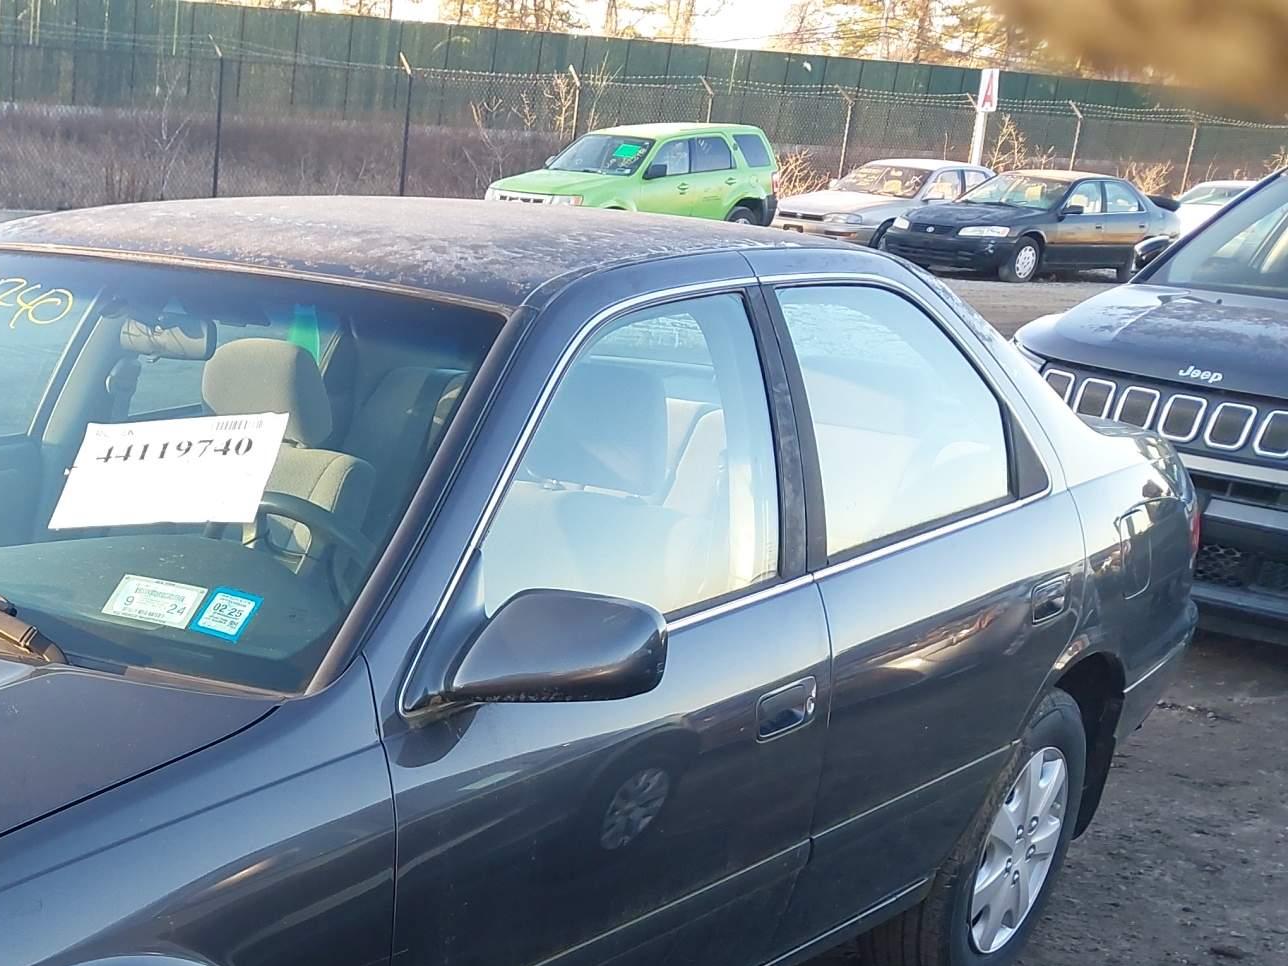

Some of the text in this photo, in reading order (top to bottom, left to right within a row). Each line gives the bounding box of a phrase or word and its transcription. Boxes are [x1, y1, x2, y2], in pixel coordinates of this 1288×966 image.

[981, 70, 995, 107] A
[1178, 365, 1223, 383] Jeep
[95, 437, 254, 463] 44119740
[123, 595, 135, 607] 9
[165, 603, 187, 617] 24
